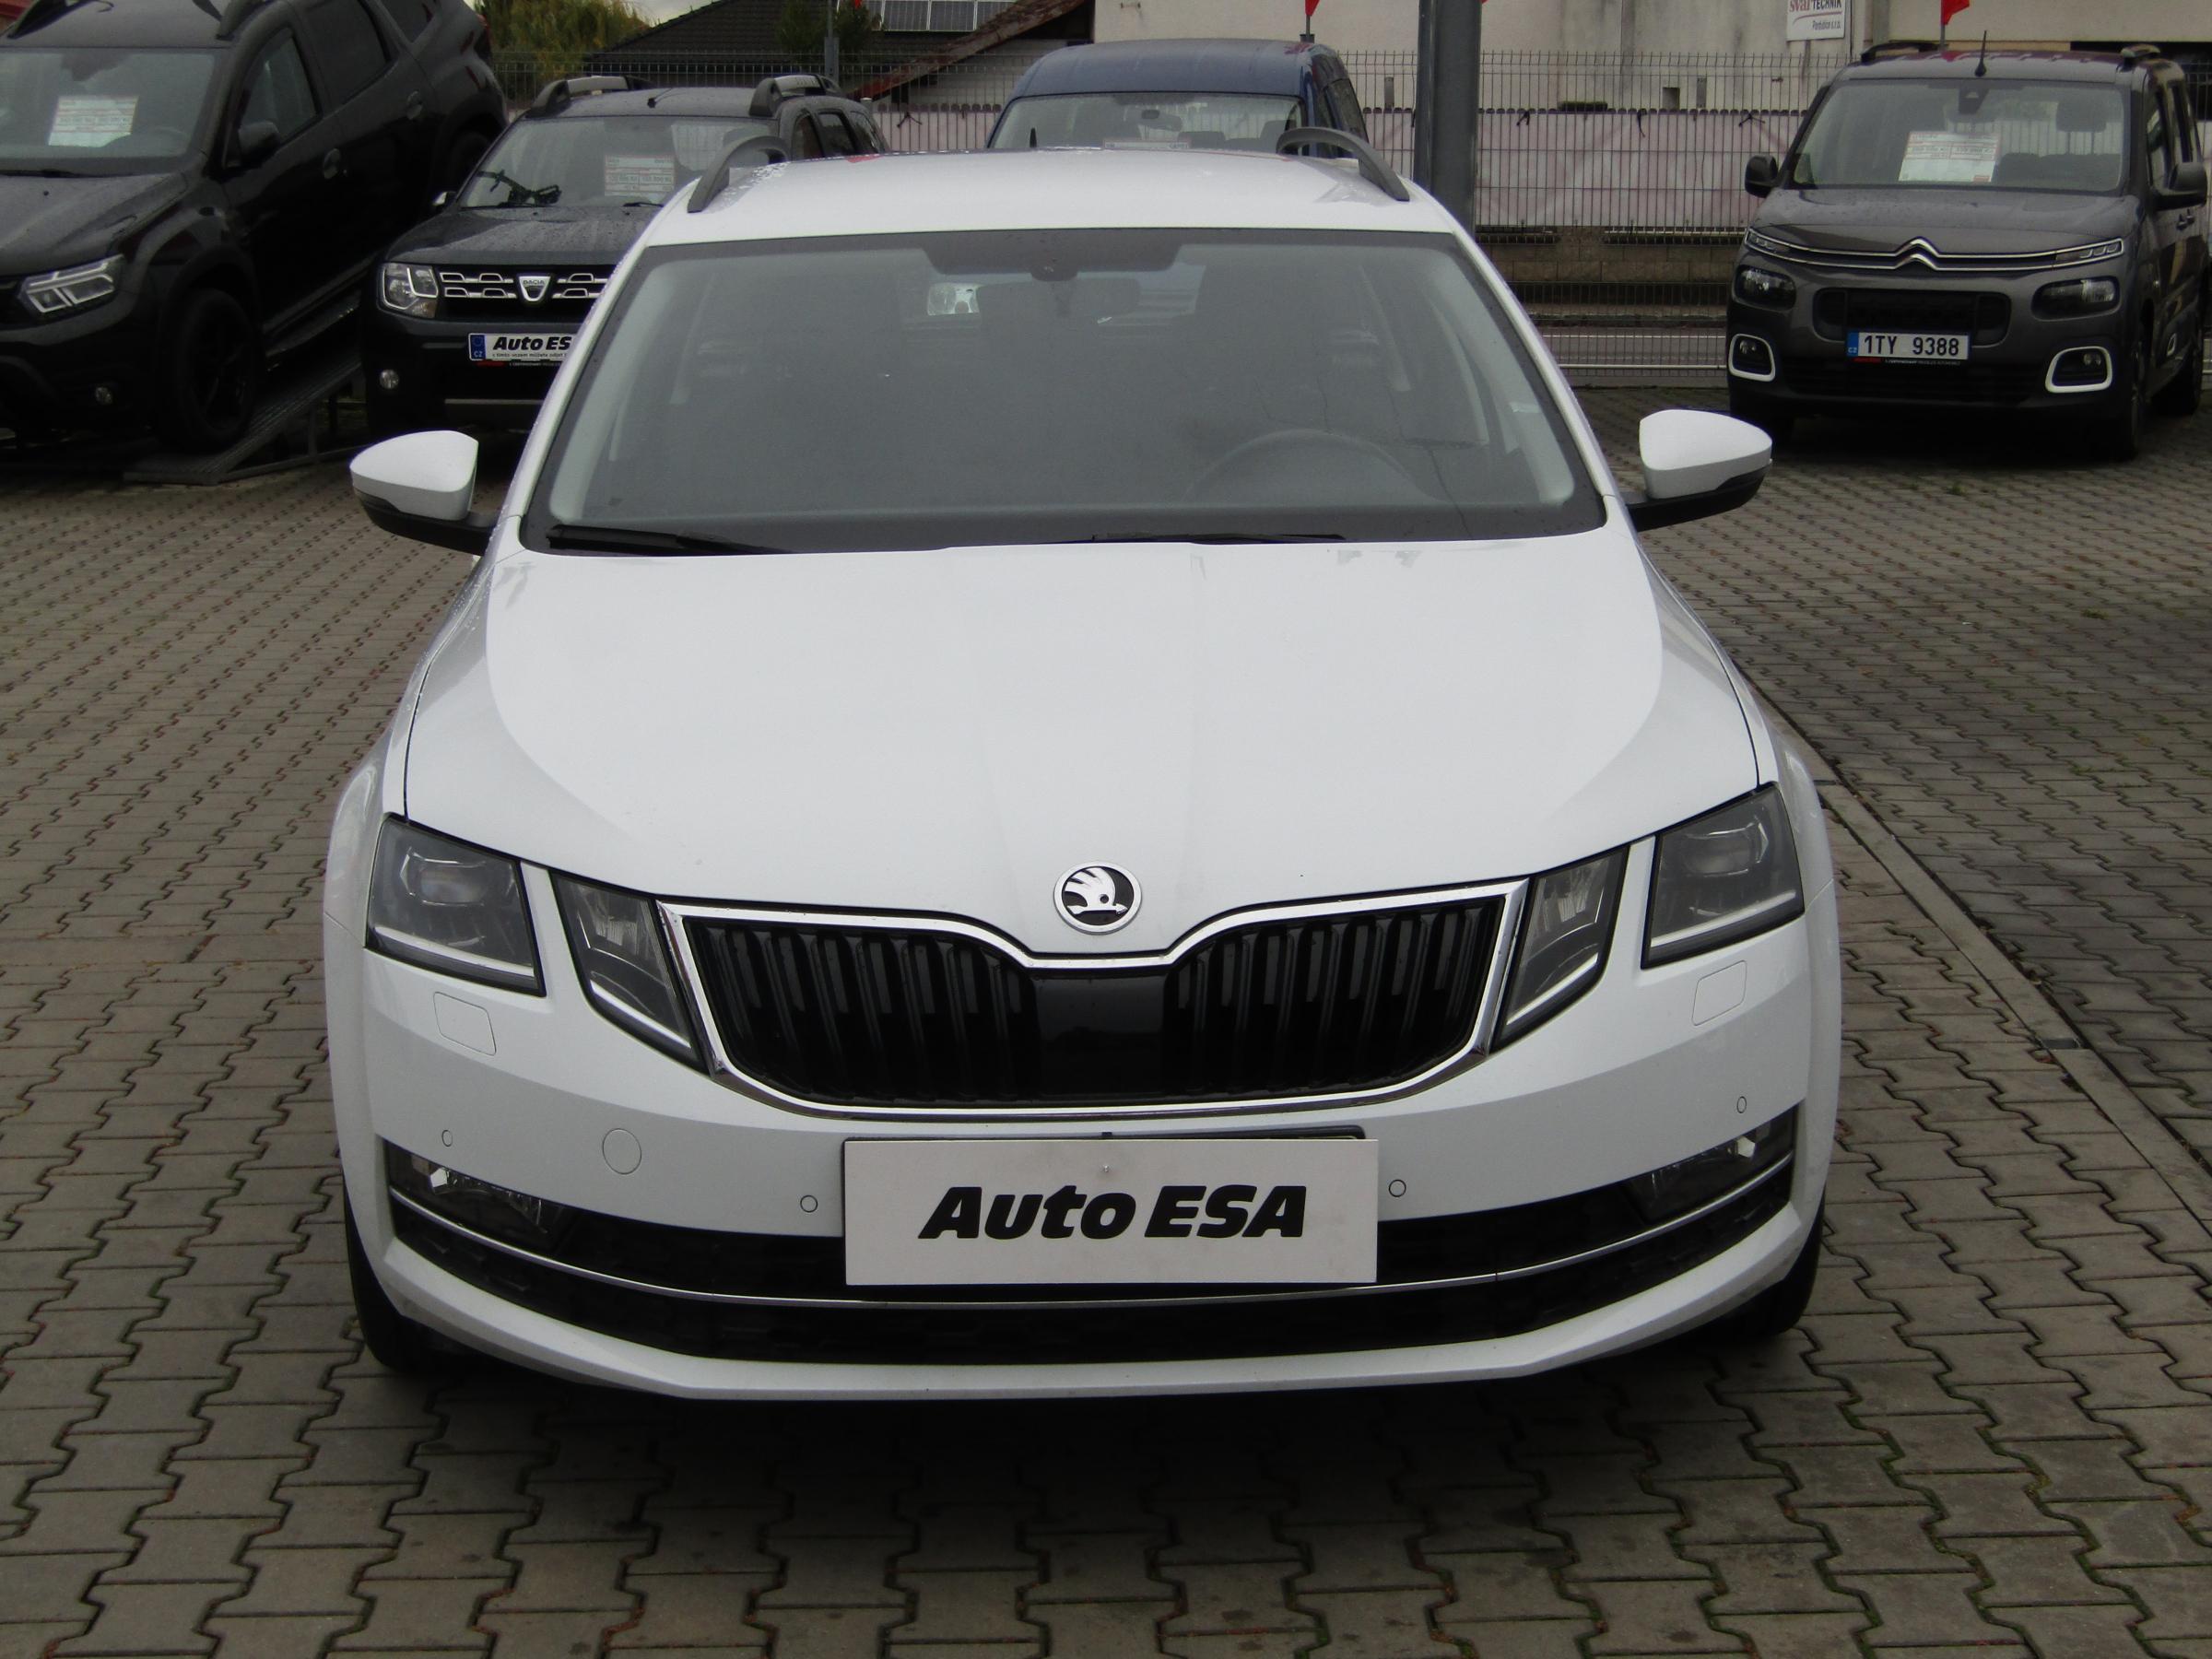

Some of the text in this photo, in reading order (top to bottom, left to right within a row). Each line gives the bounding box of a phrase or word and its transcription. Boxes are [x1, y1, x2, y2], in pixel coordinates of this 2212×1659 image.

[492, 335, 572, 351] Auto ES
[1864, 335, 1959, 356] 1TY 9388
[917, 1183, 1307, 1241] Auto ESA
